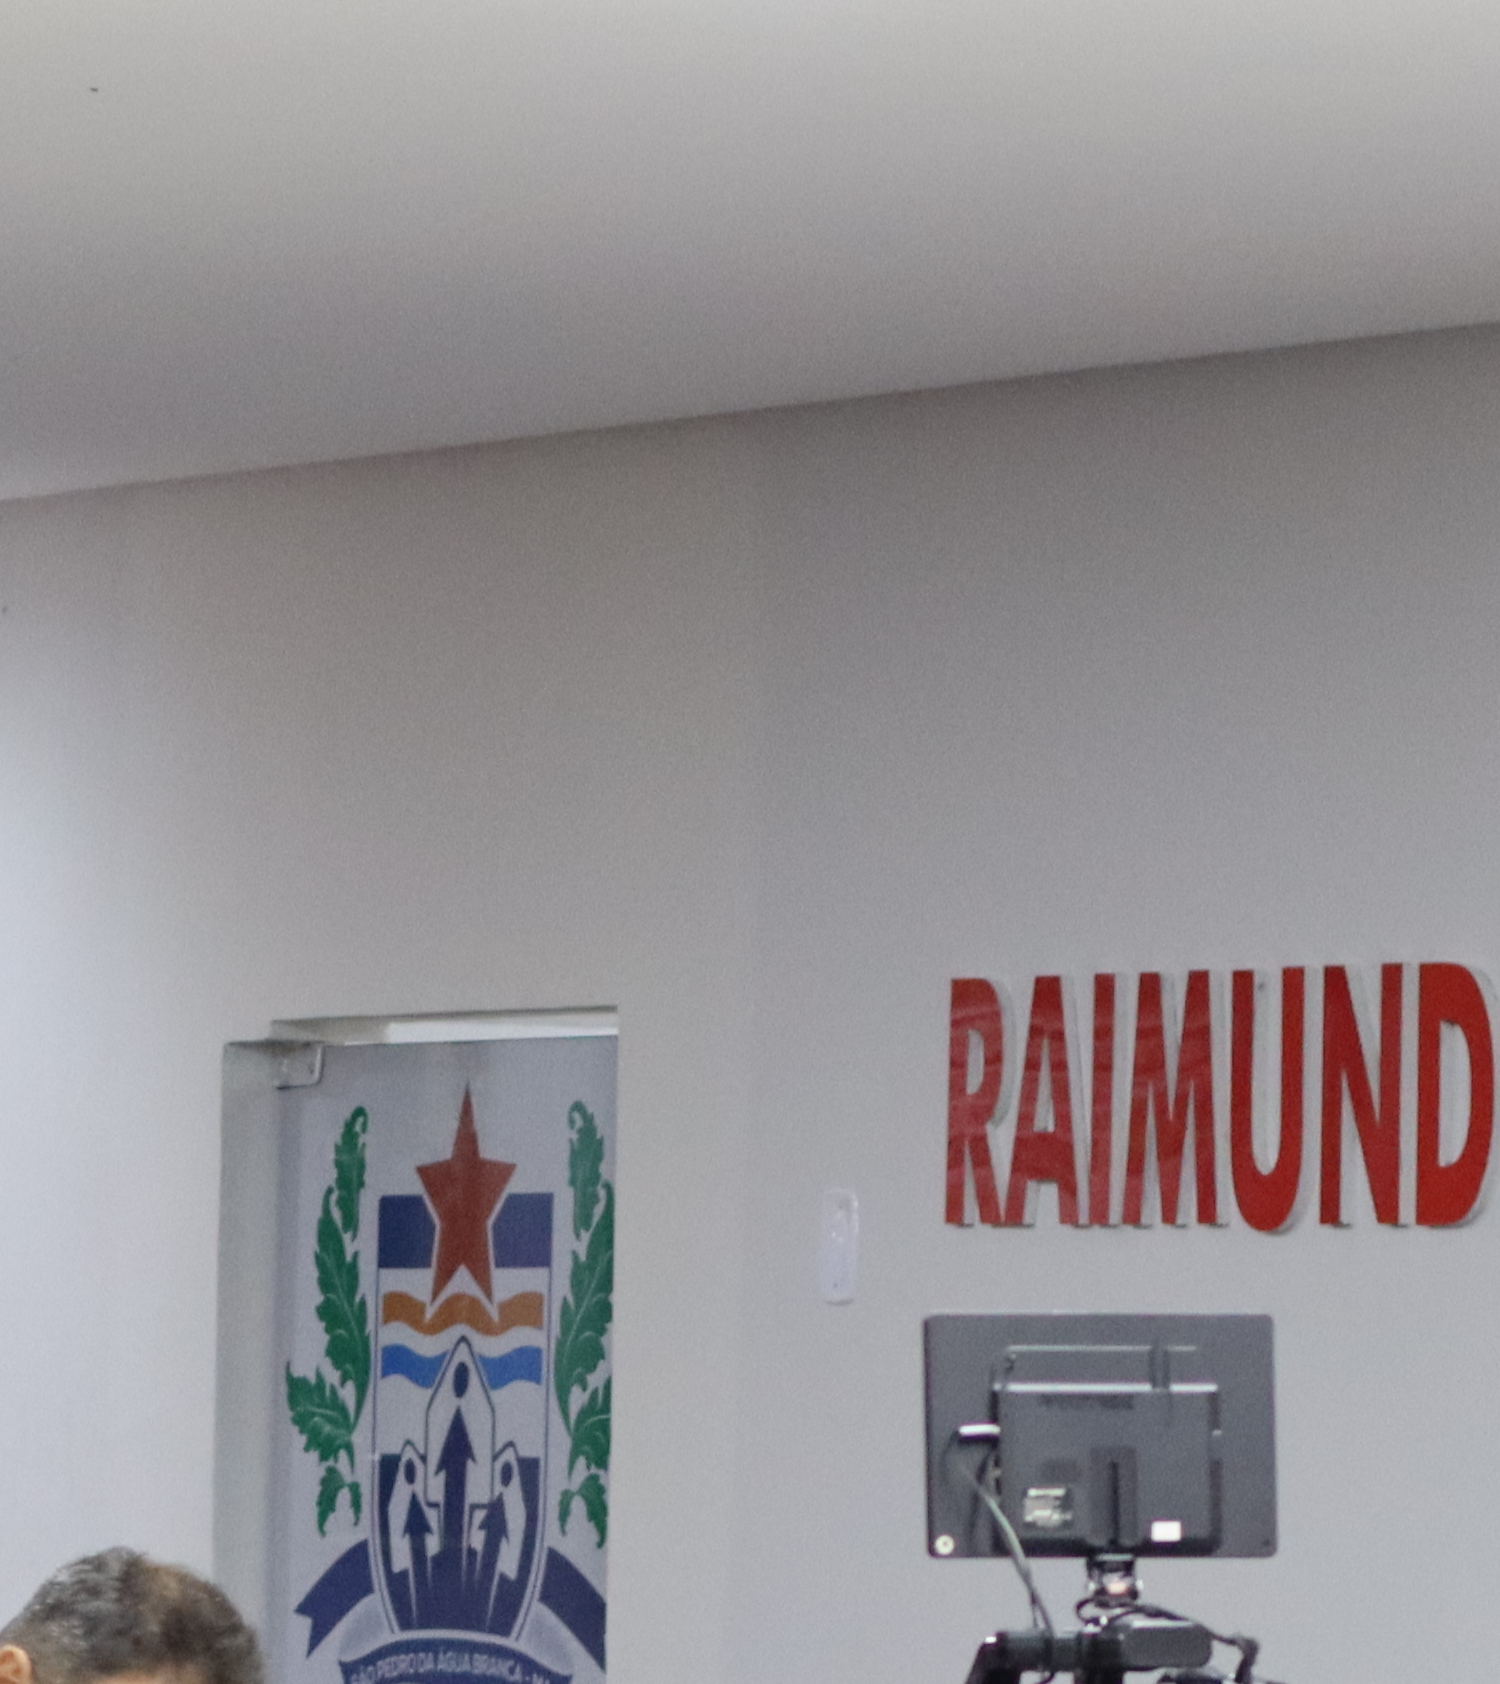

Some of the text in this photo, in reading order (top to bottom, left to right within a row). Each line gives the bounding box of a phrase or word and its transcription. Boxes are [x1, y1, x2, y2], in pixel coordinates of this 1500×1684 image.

[376, 1653, 417, 1680] PEDRO
[417, 1651, 435, 1673] DA
[472, 1651, 523, 1683] BRANCA
